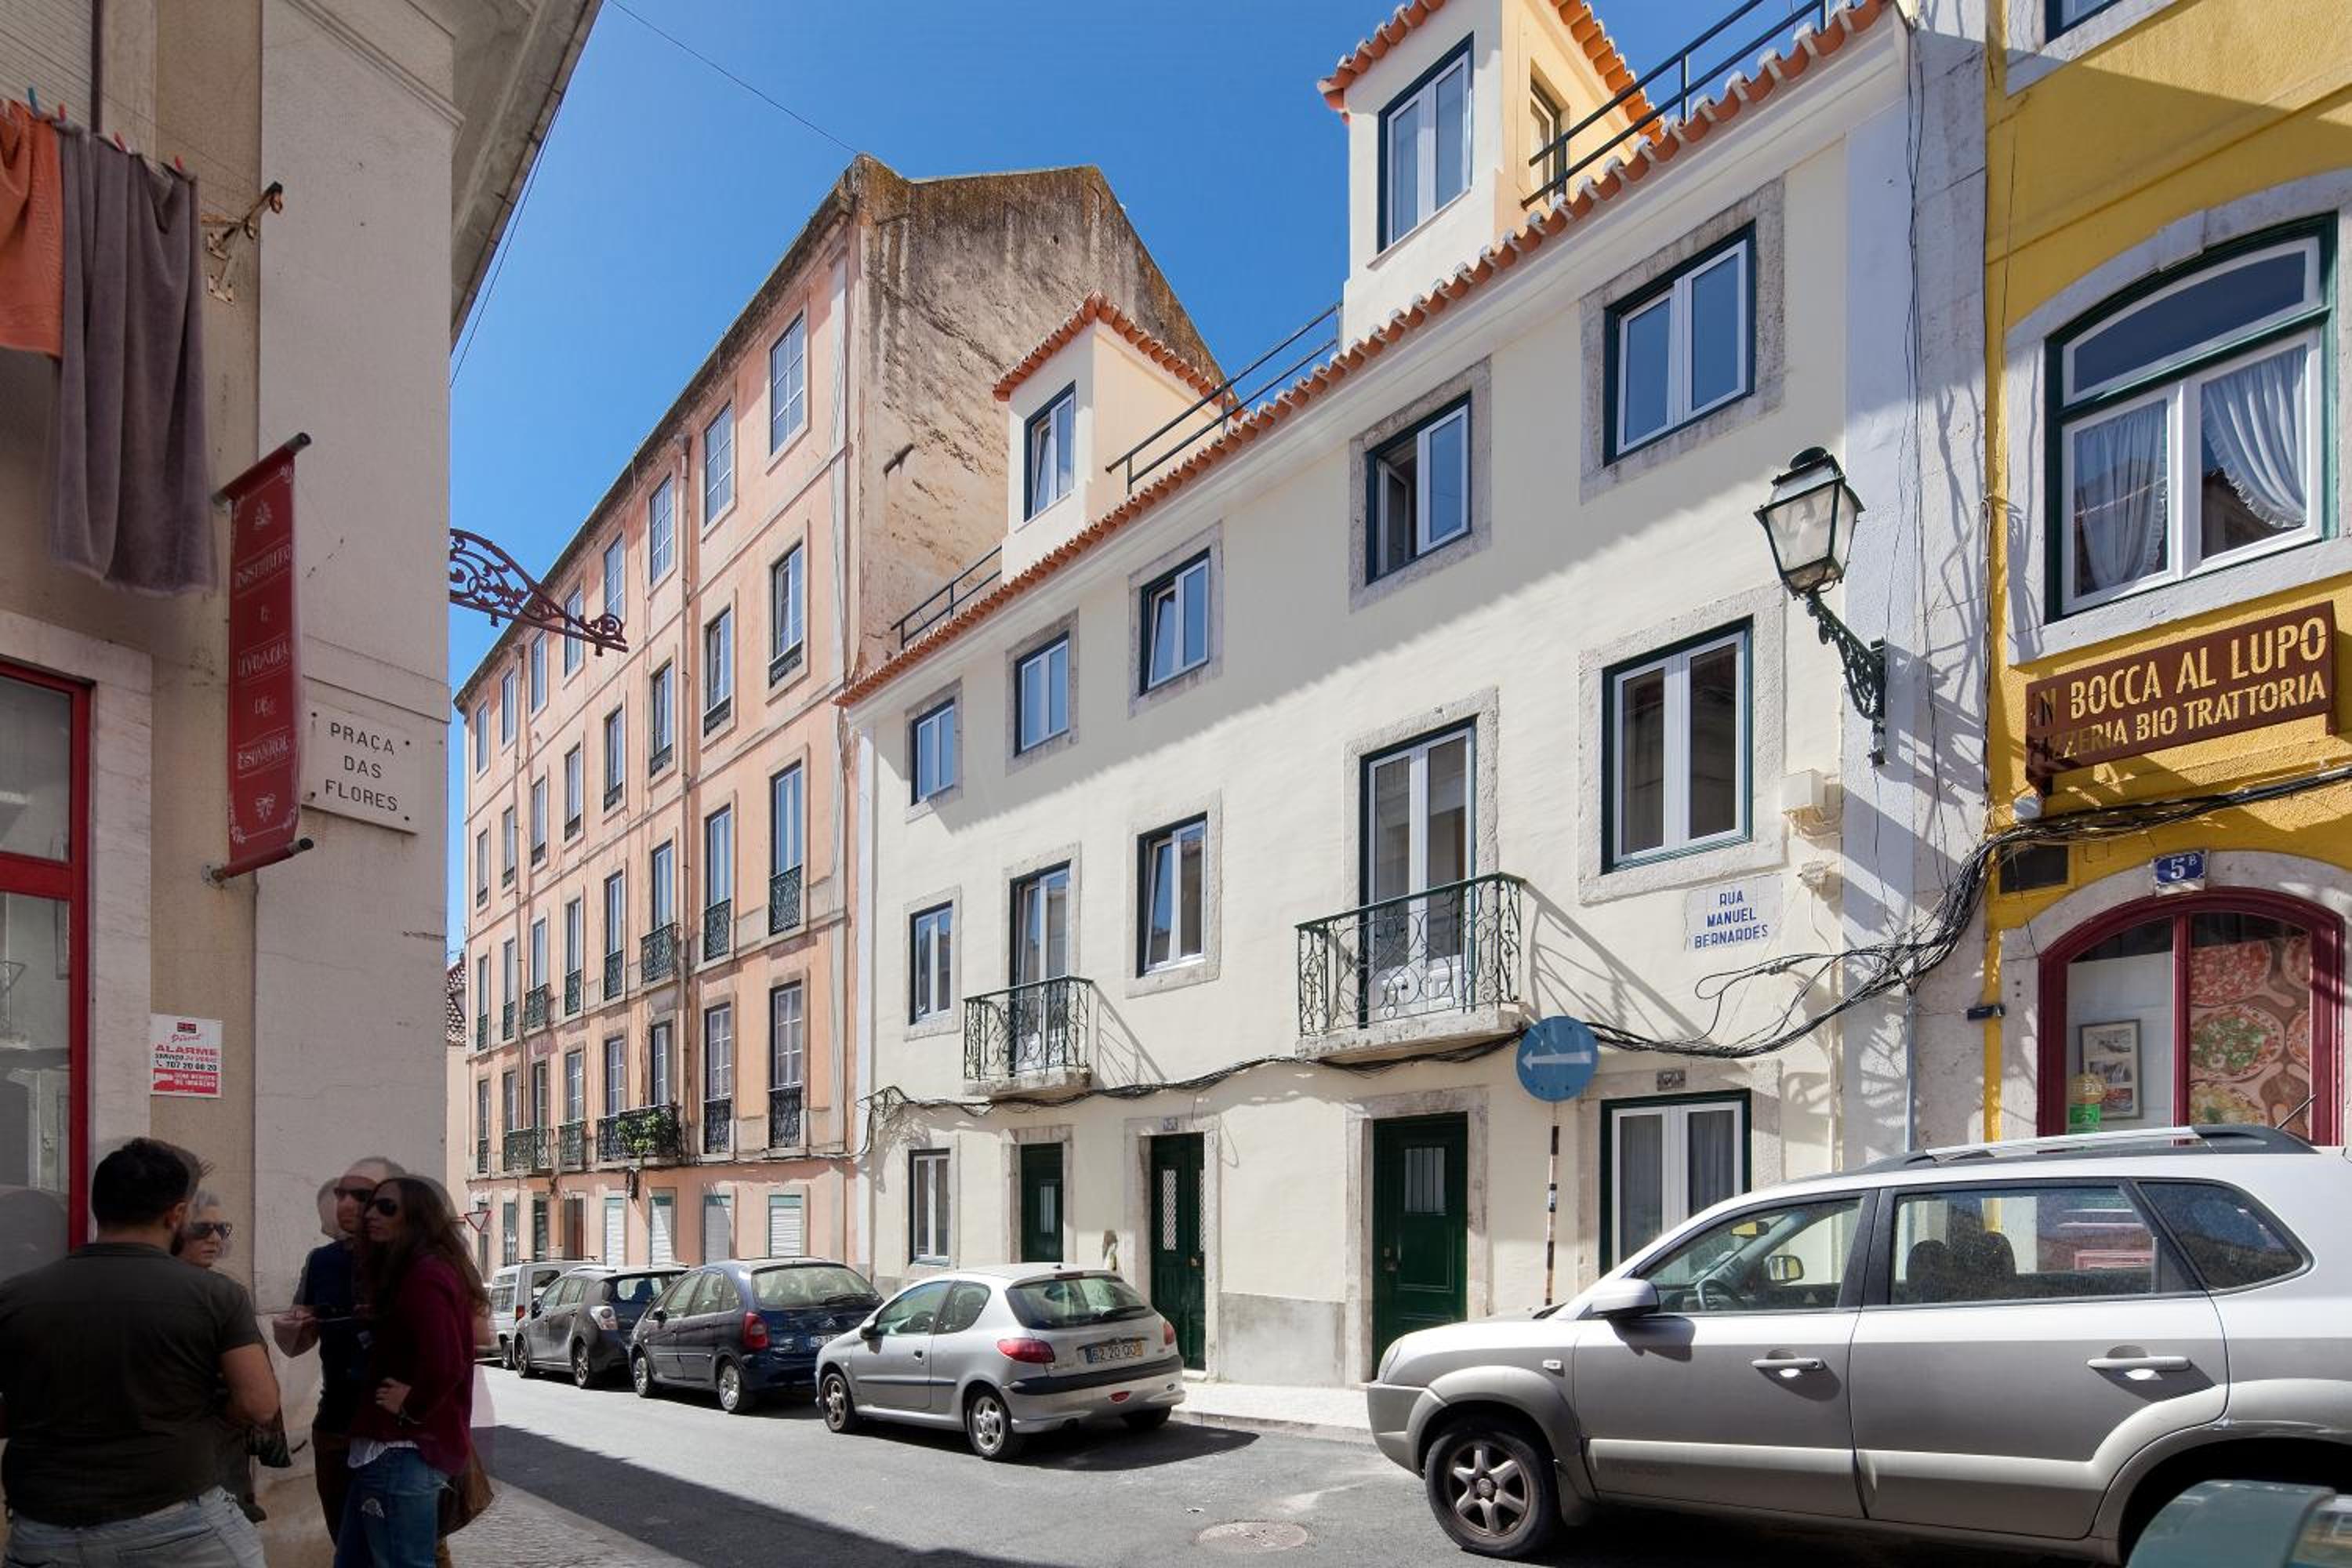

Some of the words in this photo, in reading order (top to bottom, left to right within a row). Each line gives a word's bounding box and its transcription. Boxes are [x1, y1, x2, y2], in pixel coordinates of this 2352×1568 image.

[2071, 660, 2162, 720] BOCCA
[2176, 647, 2217, 694] AL
[2230, 617, 2327, 680] LUPO
[2136, 706, 2177, 742] BIO
[2183, 670, 2326, 730] TRATTORIA
[330, 722, 395, 756] PRAÇA
[343, 755, 383, 779] DAS
[325, 779, 398, 811] FLORES
[1719, 890, 1744, 907] RUA
[1707, 908, 1757, 927] MANUEL
[1694, 924, 1769, 949] BERNARDES
[155, 1044, 217, 1055] ALARME
